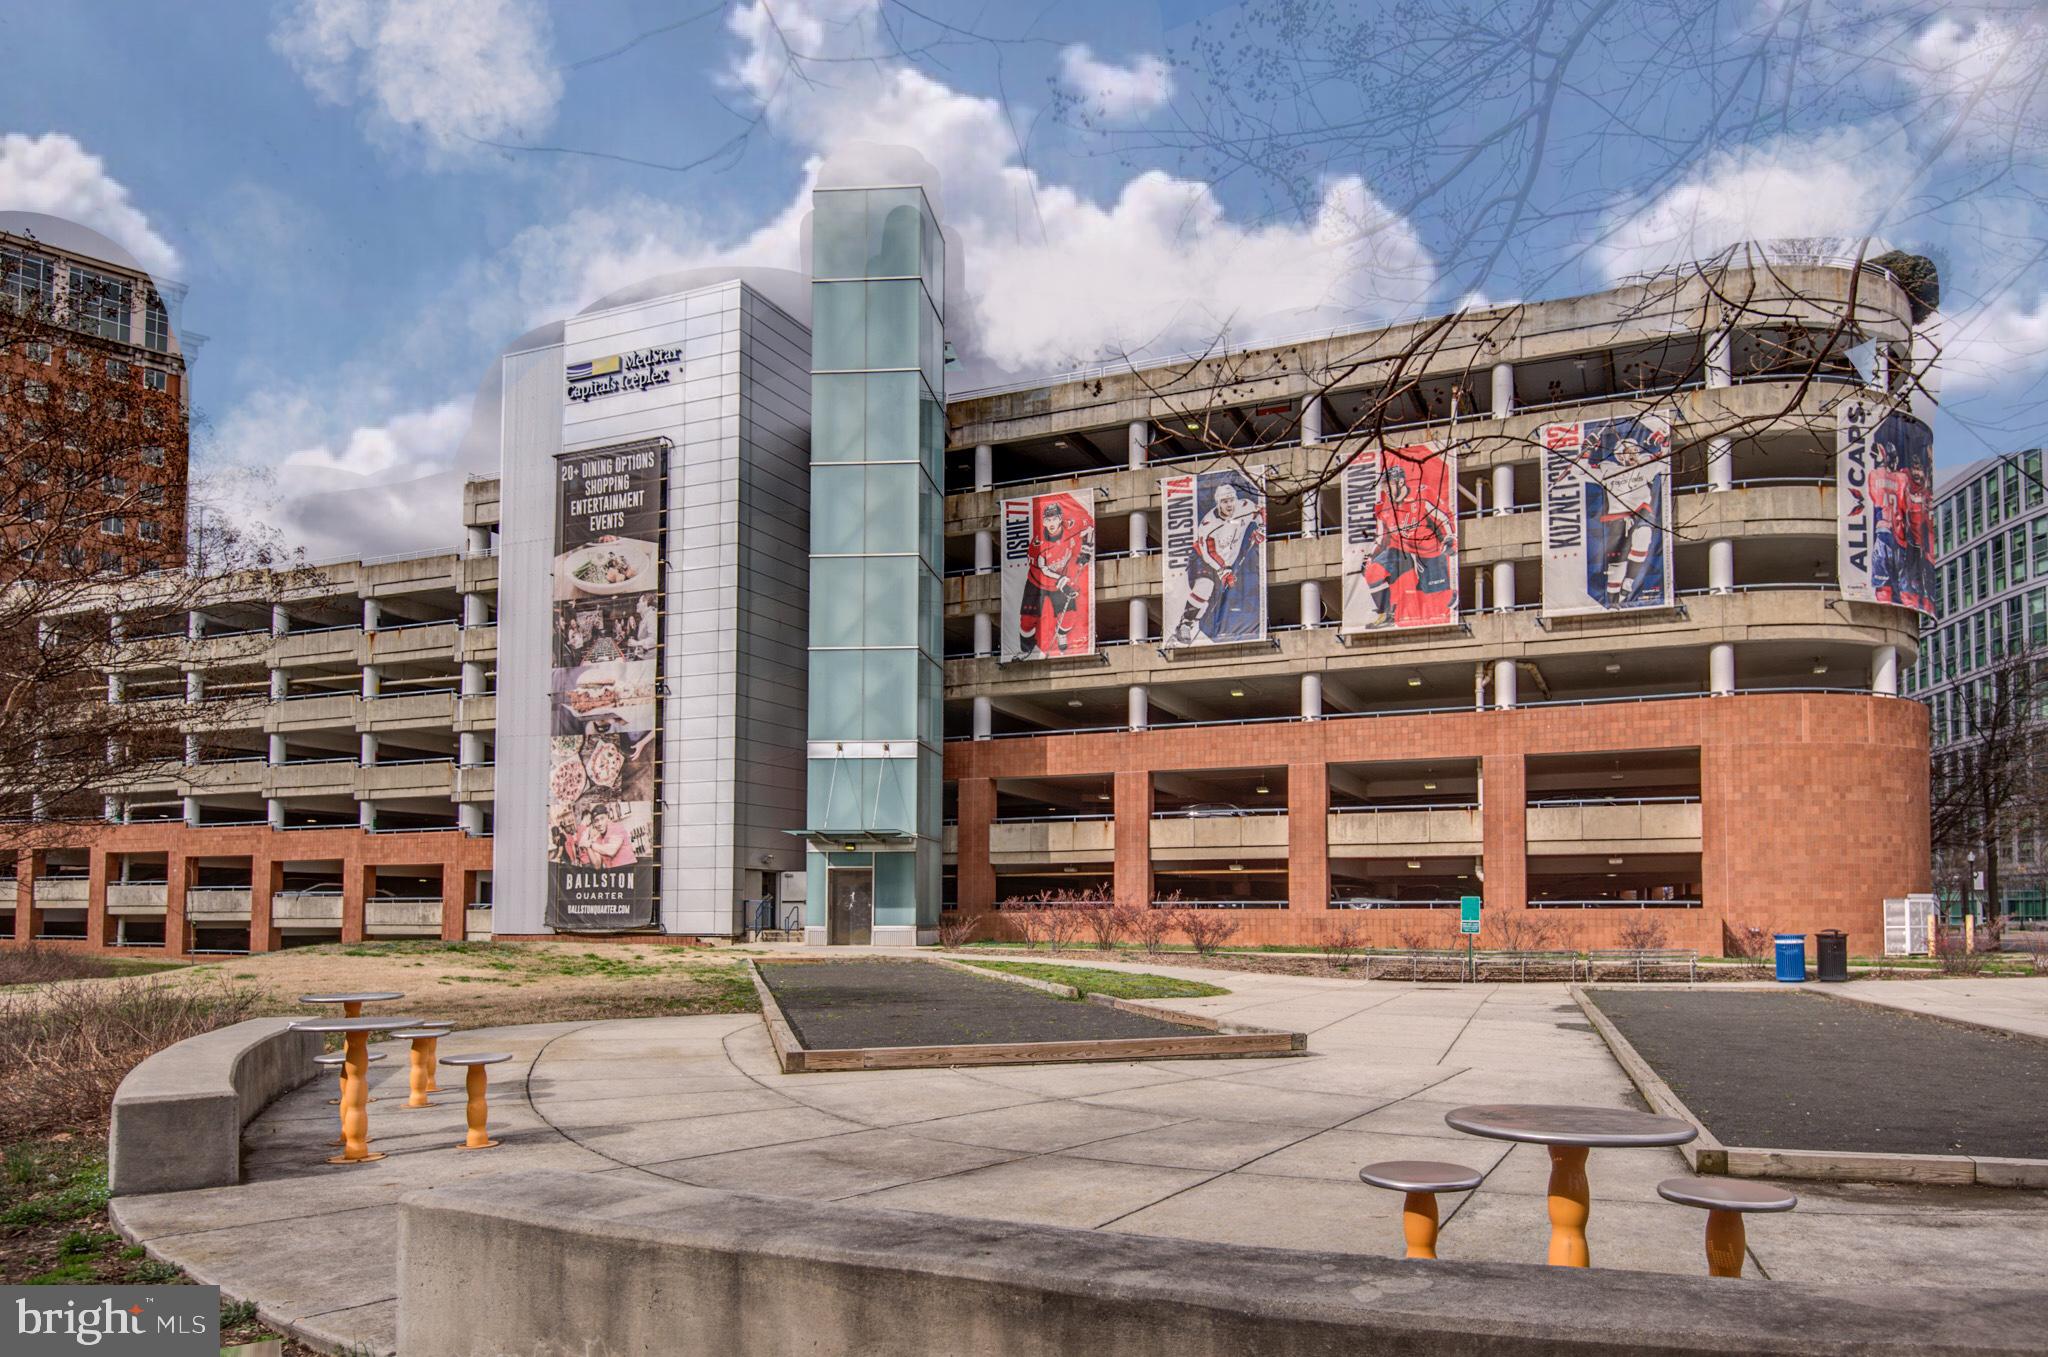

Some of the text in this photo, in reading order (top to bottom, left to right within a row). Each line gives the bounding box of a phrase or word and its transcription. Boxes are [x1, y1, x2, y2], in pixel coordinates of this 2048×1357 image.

[625, 349, 683, 371] MedStar
[567, 366, 670, 402] Capitals Iceplex
[1547, 423, 1579, 449] 92
[1848, 405, 1867, 487] CAPS
[562, 451, 655, 481] 20+ DINING OPTIONS
[585, 474, 630, 496] SHOPPING
[570, 490, 645, 516] ENTERTAINMENT
[590, 512, 624, 531] EVENTS
[1006, 501, 1030, 560] OSHIE 77
[1167, 476, 1194, 571] CARLSON 74
[1848, 515, 1868, 573] ALL
[566, 873, 634, 890] BALLSTON
[576, 892, 624, 900] QUARTER
[567, 904, 631, 915] BALLSTONQUARTER.COM
